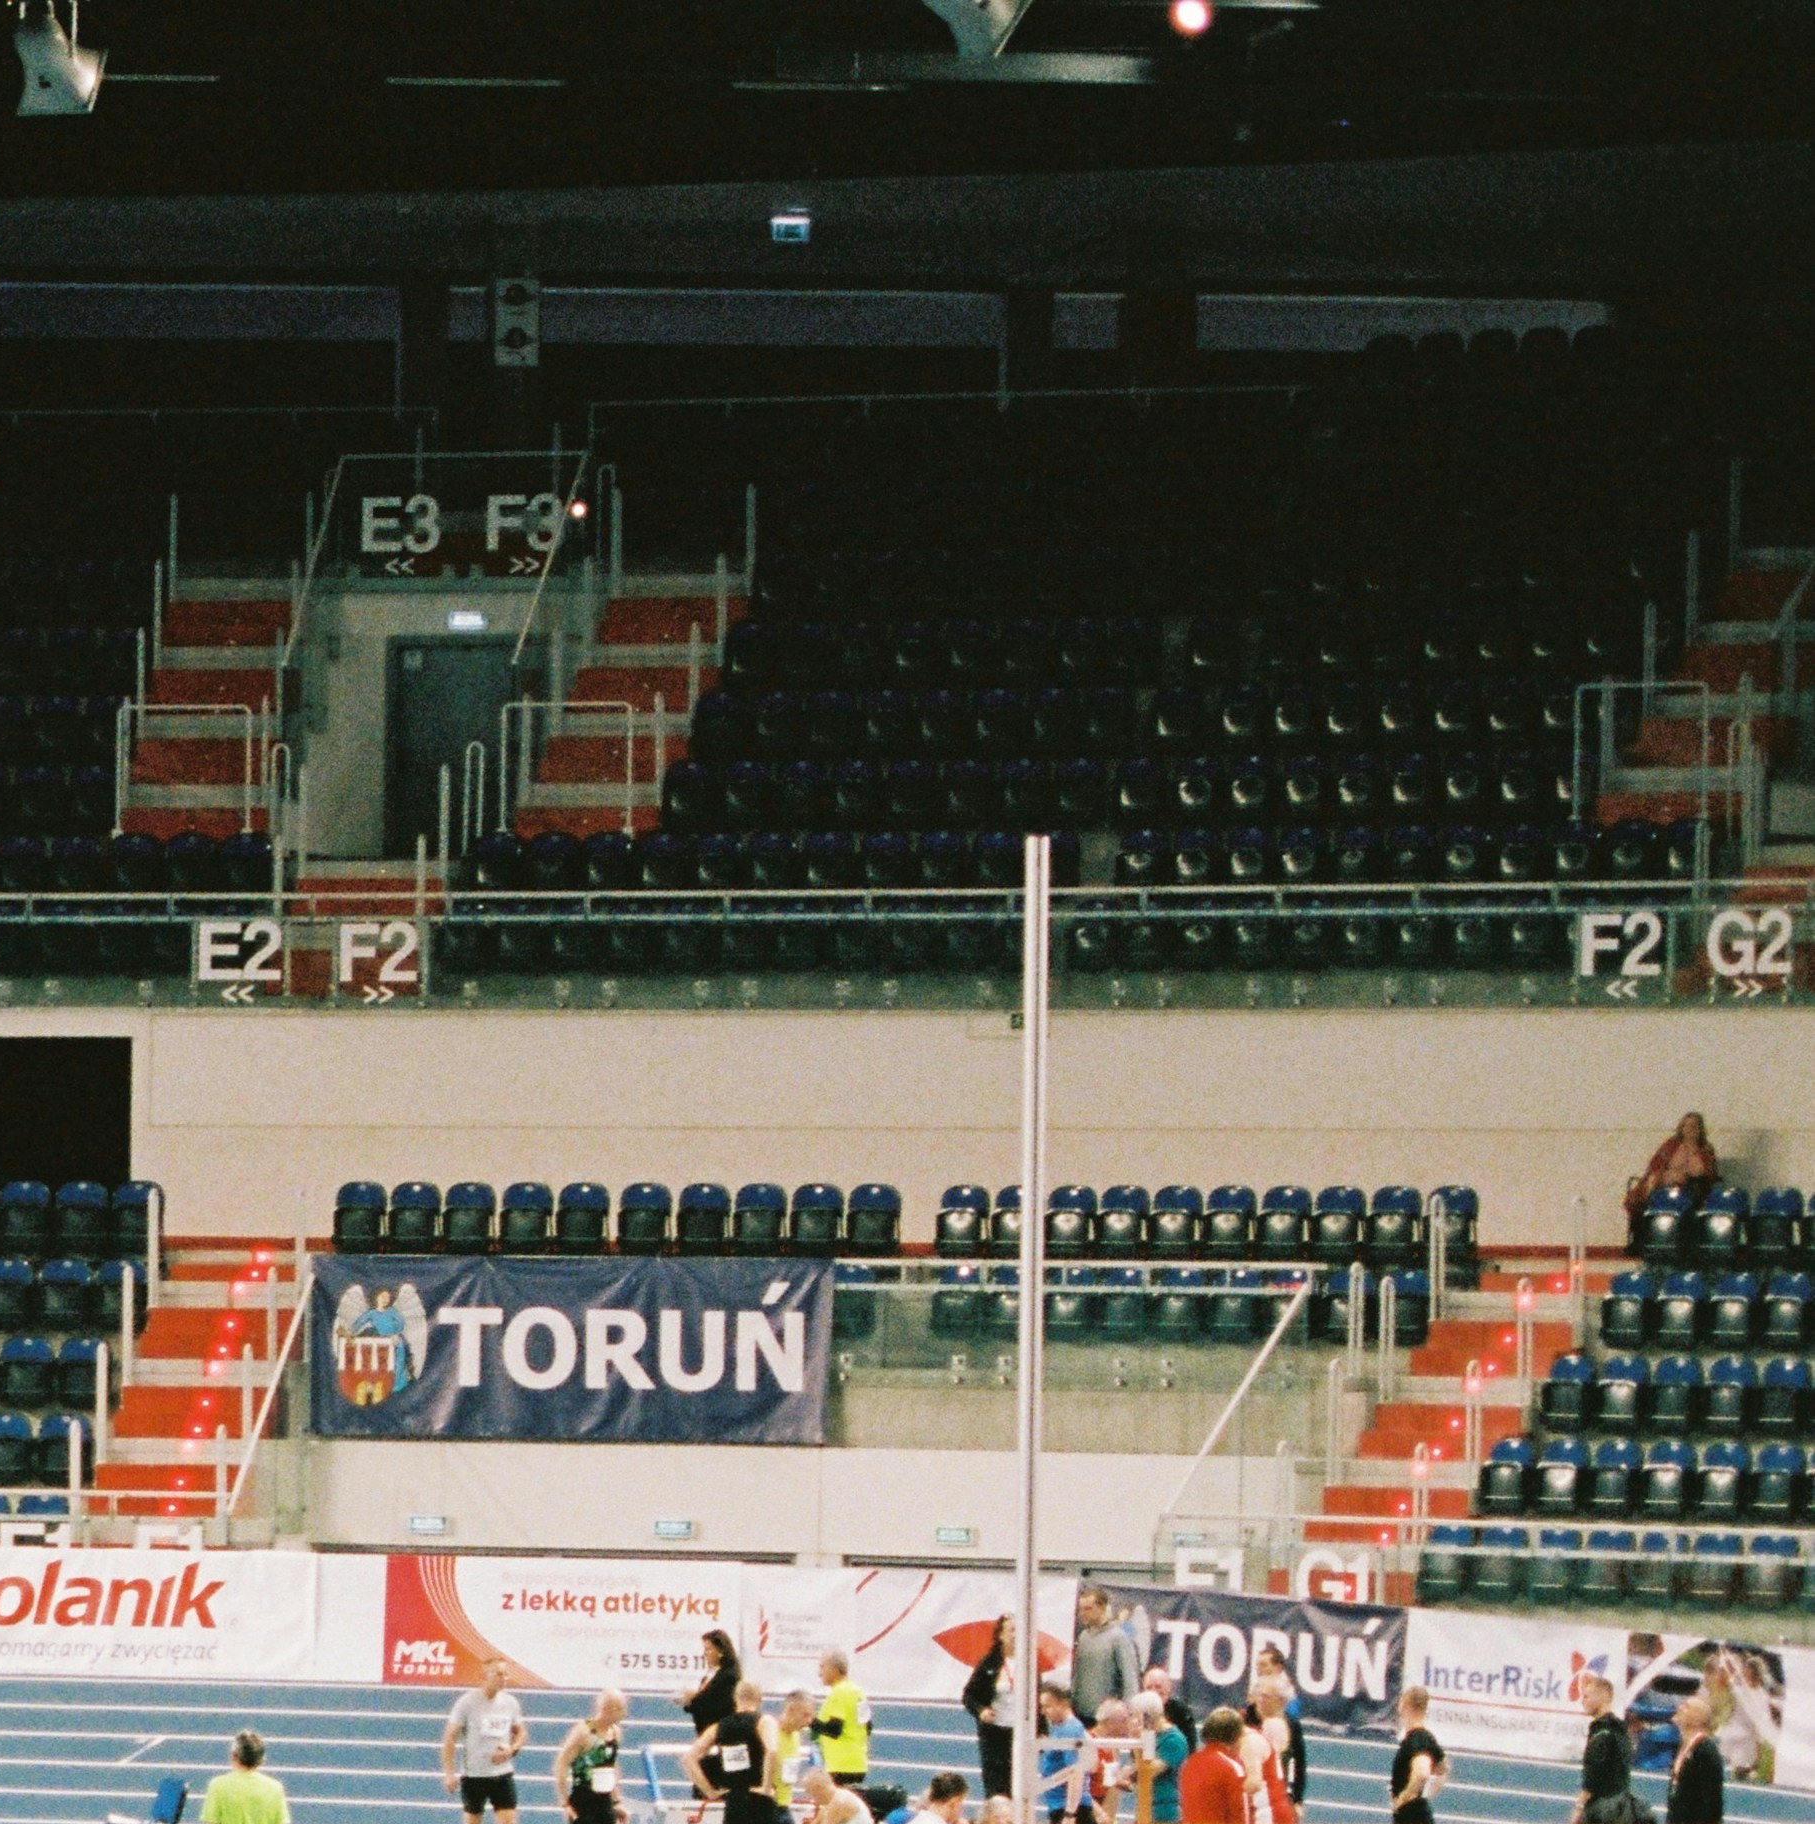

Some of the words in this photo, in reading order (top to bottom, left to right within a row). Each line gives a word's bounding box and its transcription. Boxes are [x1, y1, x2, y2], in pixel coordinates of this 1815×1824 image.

[361, 495, 442, 553] E3
[486, 493, 562, 553] F3
[197, 919, 283, 982] E2
[338, 922, 419, 983] F2
[1579, 912, 1663, 977] F2
[1707, 909, 1794, 977] G2
[438, 1281, 804, 1394] TORUŃ
[501, 1592, 515, 1611] z
[520, 1588, 598, 1619] lekką
[602, 1591, 721, 1622] atletyką
[393, 1640, 456, 1665] MKL
[620, 1653, 652, 1670] 575
[656, 1654, 689, 1671] 533
[692, 1655, 708, 1671] 11
[1157, 1619, 1389, 1700] TORUŃ
[1423, 1655, 1562, 1700] InterRisk
